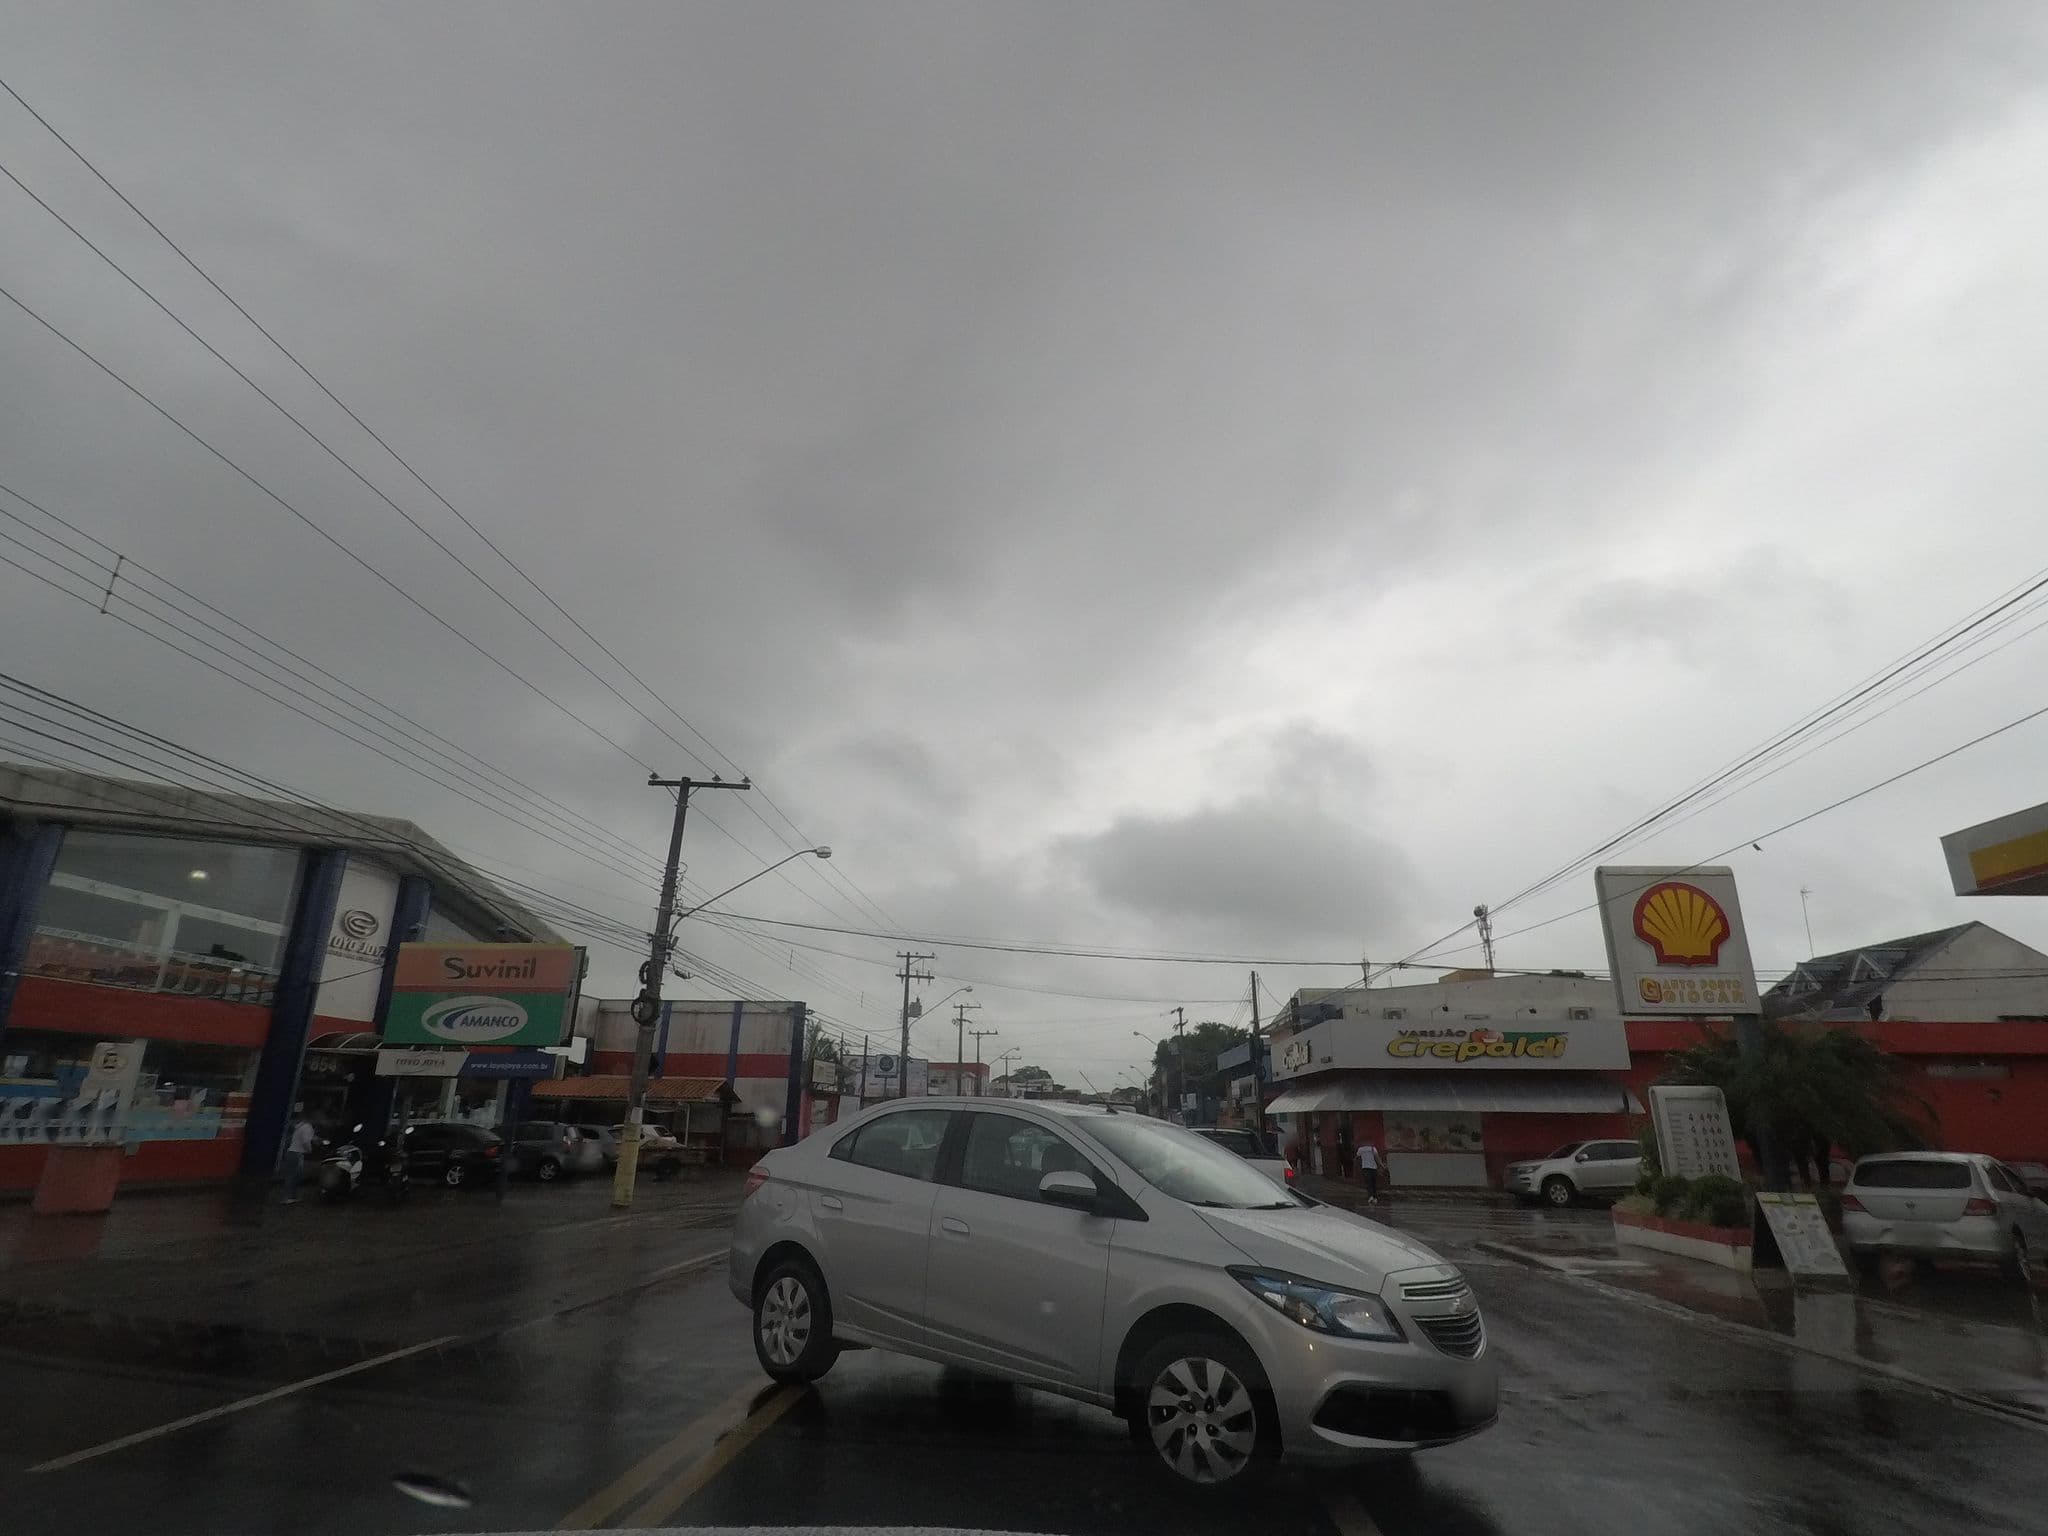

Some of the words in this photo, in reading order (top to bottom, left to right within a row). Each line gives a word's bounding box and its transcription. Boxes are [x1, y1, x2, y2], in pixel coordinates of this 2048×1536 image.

[443, 956, 537, 980] Suvinil
[1663, 990, 1745, 1003] GIOCAR
[459, 1015, 520, 1028] AMANCO
[1397, 1028, 1467, 1038] VAREJÃO
[1386, 1036, 1568, 1063] Crepaldi
